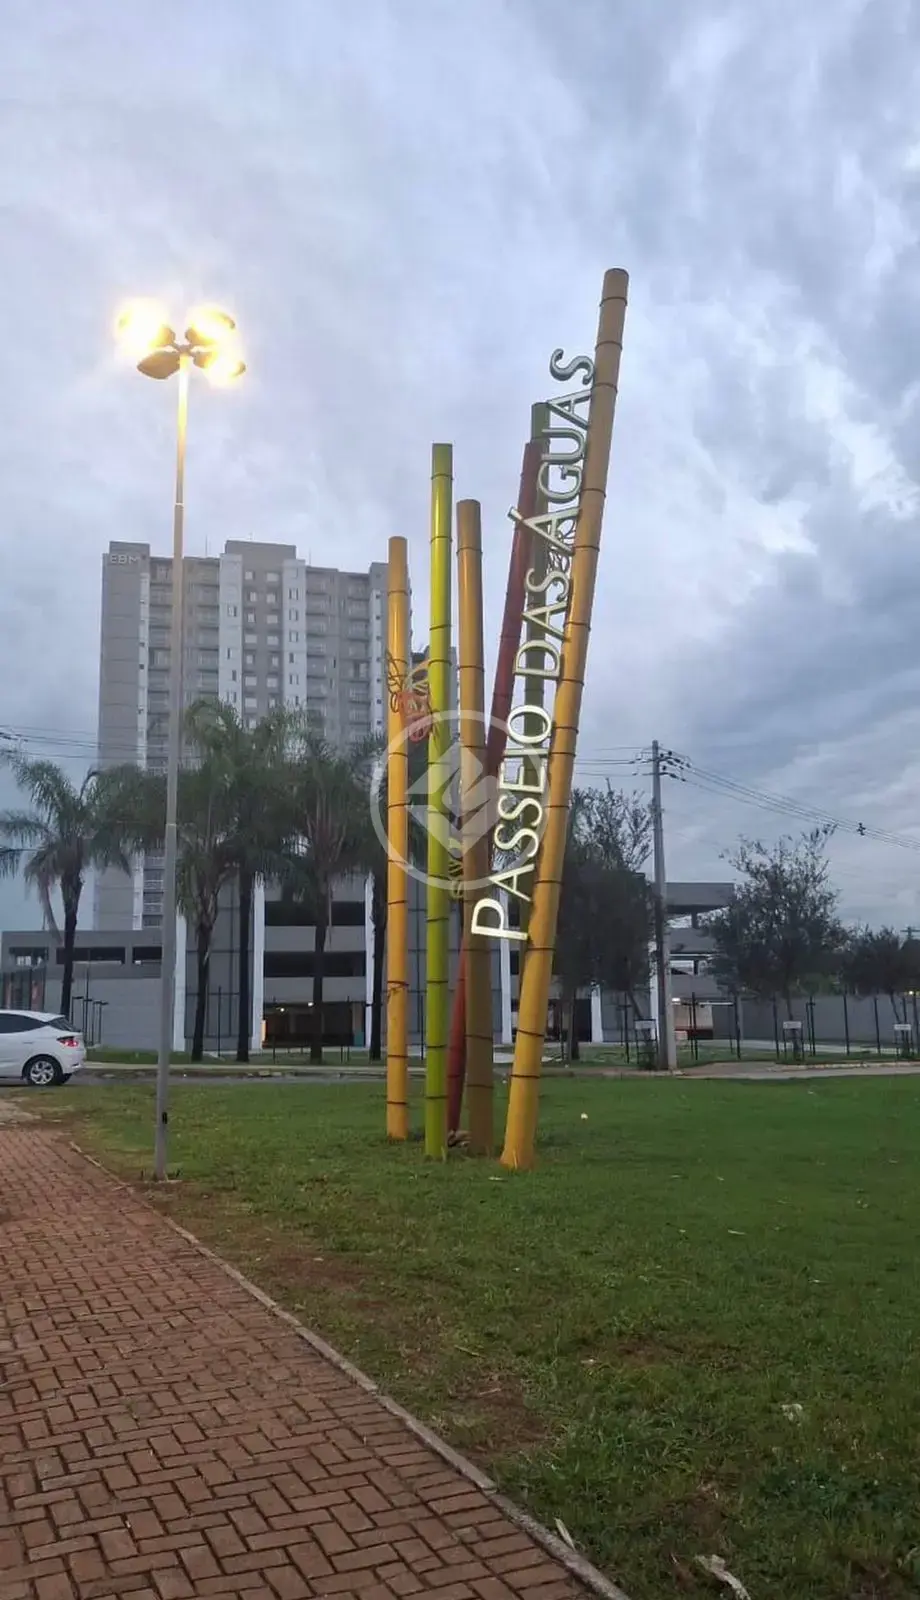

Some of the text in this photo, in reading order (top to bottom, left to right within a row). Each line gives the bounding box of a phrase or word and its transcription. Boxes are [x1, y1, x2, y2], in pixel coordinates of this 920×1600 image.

[471, 347, 596, 941] PASSEIO DAS ÁGUAS
